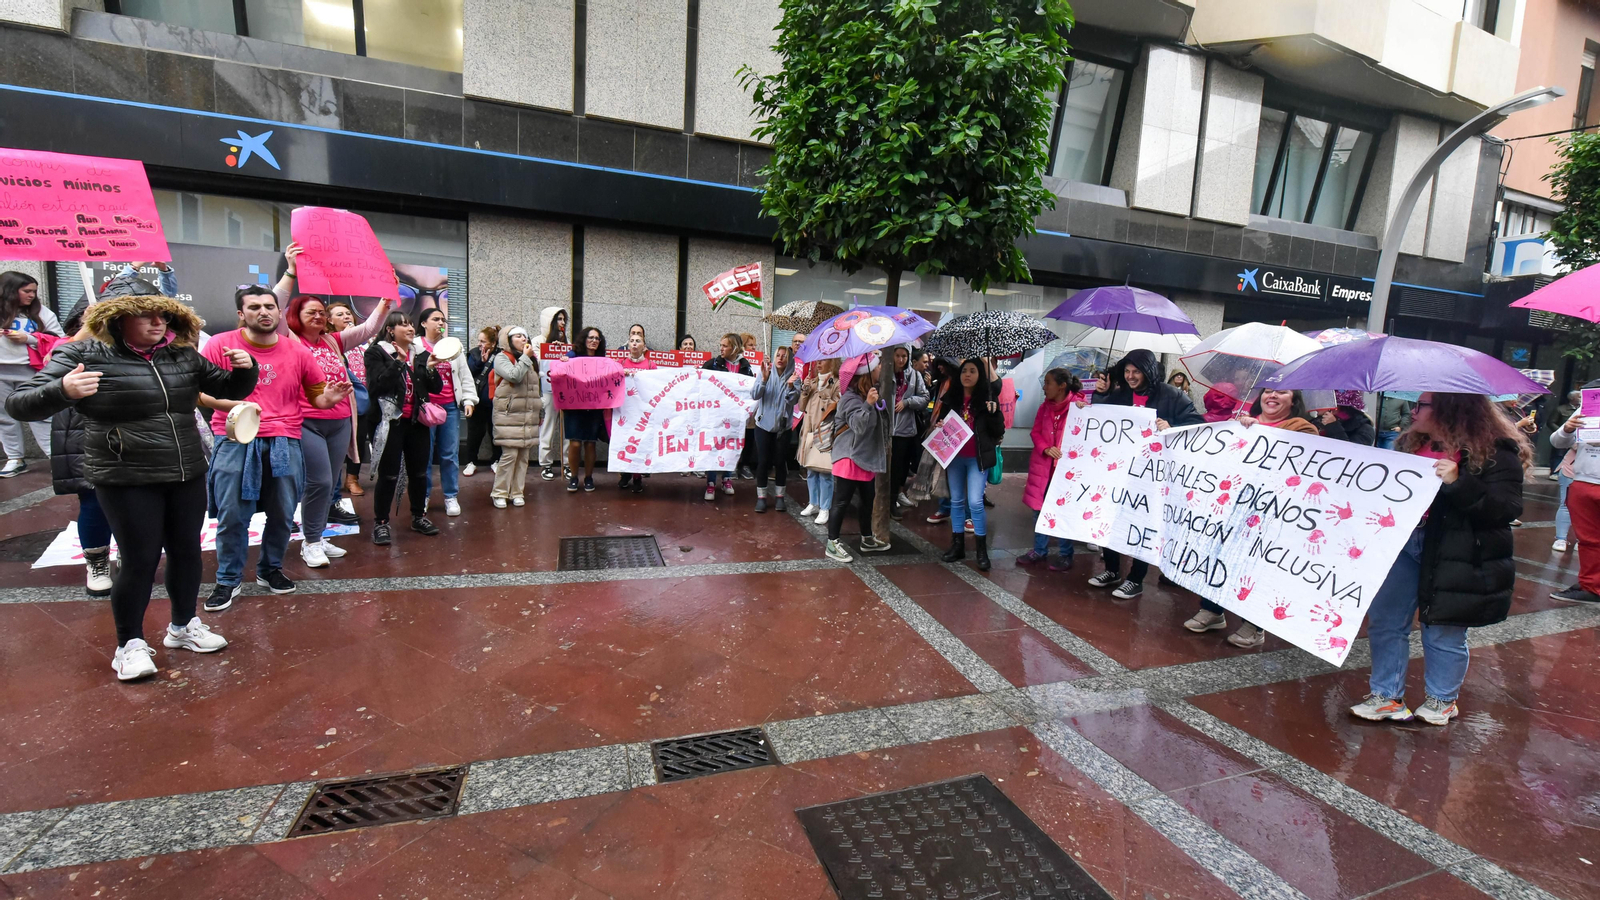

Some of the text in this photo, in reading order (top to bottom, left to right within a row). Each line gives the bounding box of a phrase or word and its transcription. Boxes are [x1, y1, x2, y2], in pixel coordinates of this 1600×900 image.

[309, 235, 339, 252] EN
[1262, 271, 1321, 295] CaixaBank
[548, 344, 573, 352] CCOO
[650, 351, 675, 360] CCOO
[617, 436, 641, 463] POR
[635, 411, 652, 432] UNA
[695, 371, 704, 379] Y
[708, 375, 745, 406] DERECHOS
[1085, 418, 1135, 445] POR
[1242, 435, 1423, 503] DERECHOS
[1076, 483, 1091, 502] Y
[1111, 487, 1150, 513] UNA
[1126, 524, 1158, 551] DE
